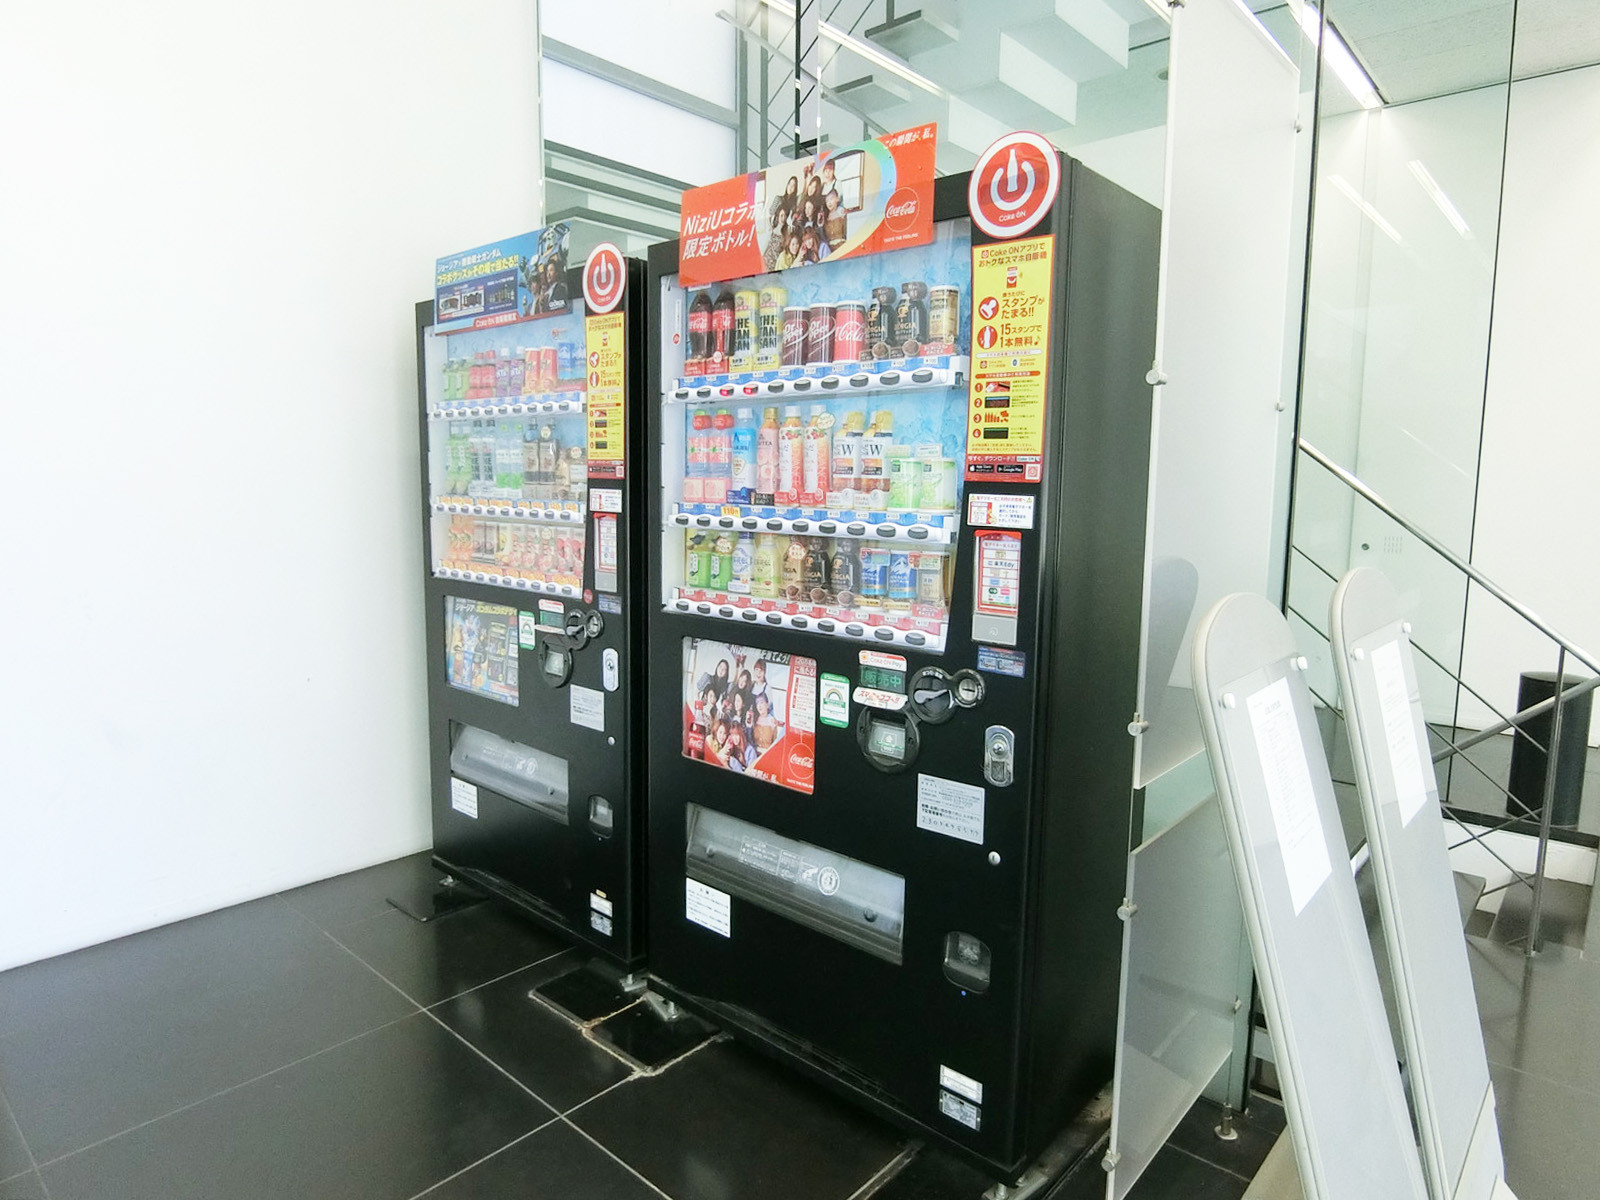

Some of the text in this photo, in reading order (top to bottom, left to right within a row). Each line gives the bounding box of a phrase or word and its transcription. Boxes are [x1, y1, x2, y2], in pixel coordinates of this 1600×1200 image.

[886, 200, 917, 219] Coca-Cola
[998, 210, 1026, 222] Coke ON
[682, 225, 756, 262] 限定ボトル!
[989, 249, 1008, 258] Coke
[1001, 294, 1045, 309] スタンプが
[1001, 307, 1034, 319] たまる!!
[1000, 323, 1042, 335] 15スタンプで
